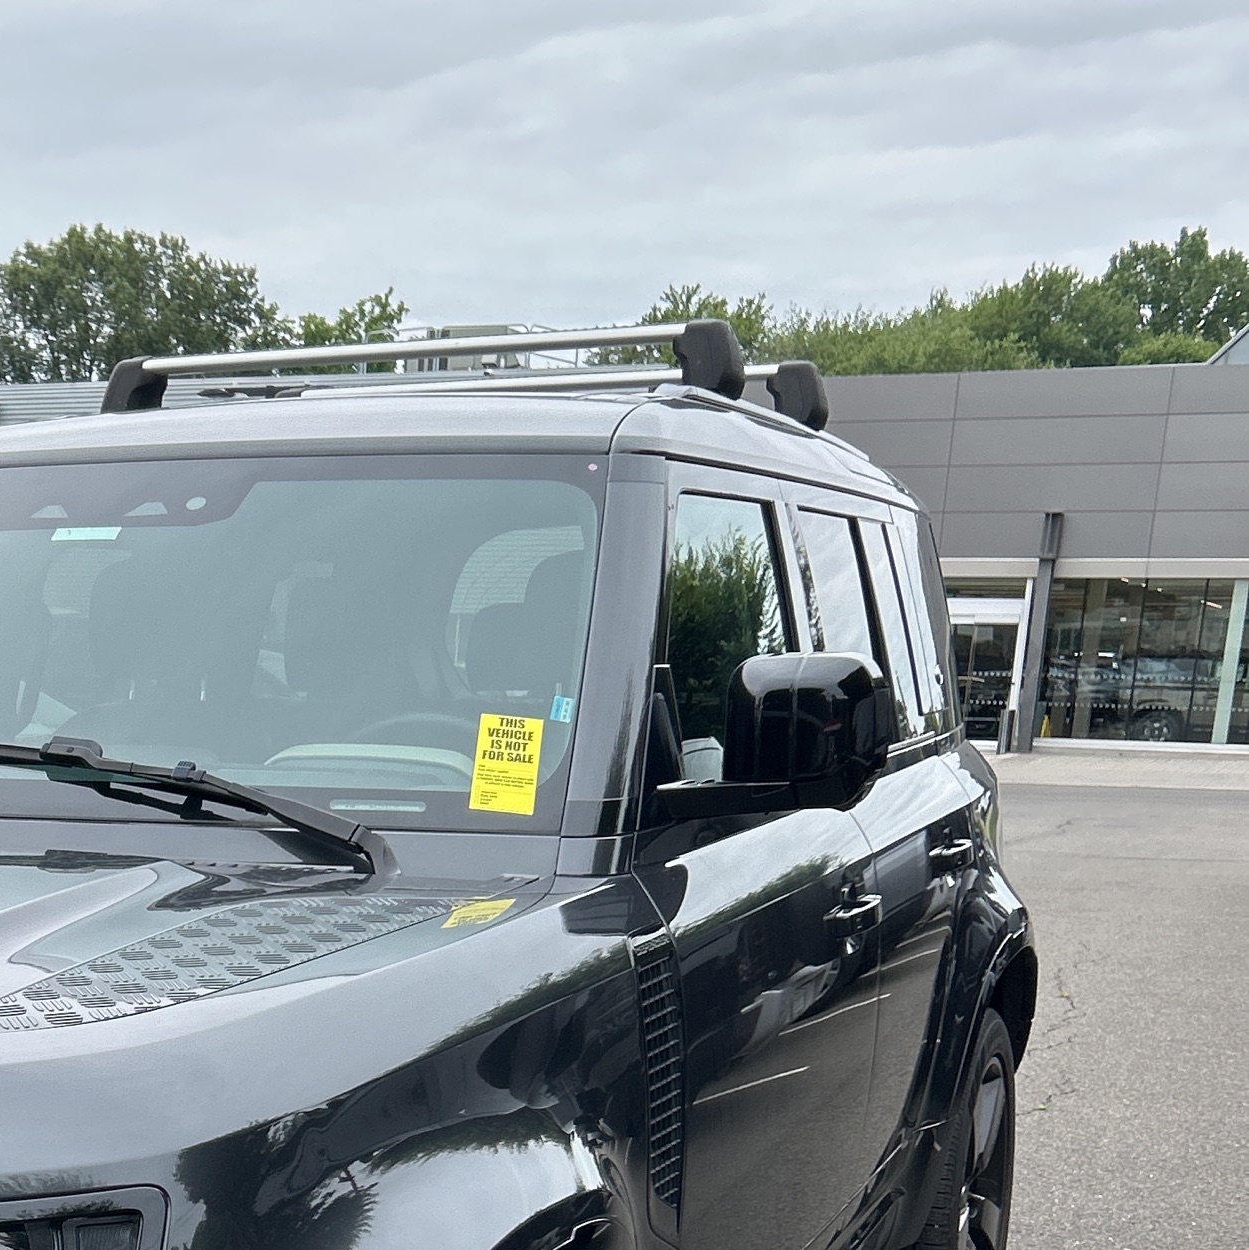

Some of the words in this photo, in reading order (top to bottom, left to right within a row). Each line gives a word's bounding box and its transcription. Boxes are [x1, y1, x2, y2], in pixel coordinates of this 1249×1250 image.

[499, 717, 526, 729] THIS
[487, 727, 534, 742] VEHICLE
[490, 739, 503, 750] IS
[505, 740, 529, 752] NOT
[482, 750, 504, 762] FOR
[506, 752, 534, 764] SALE
